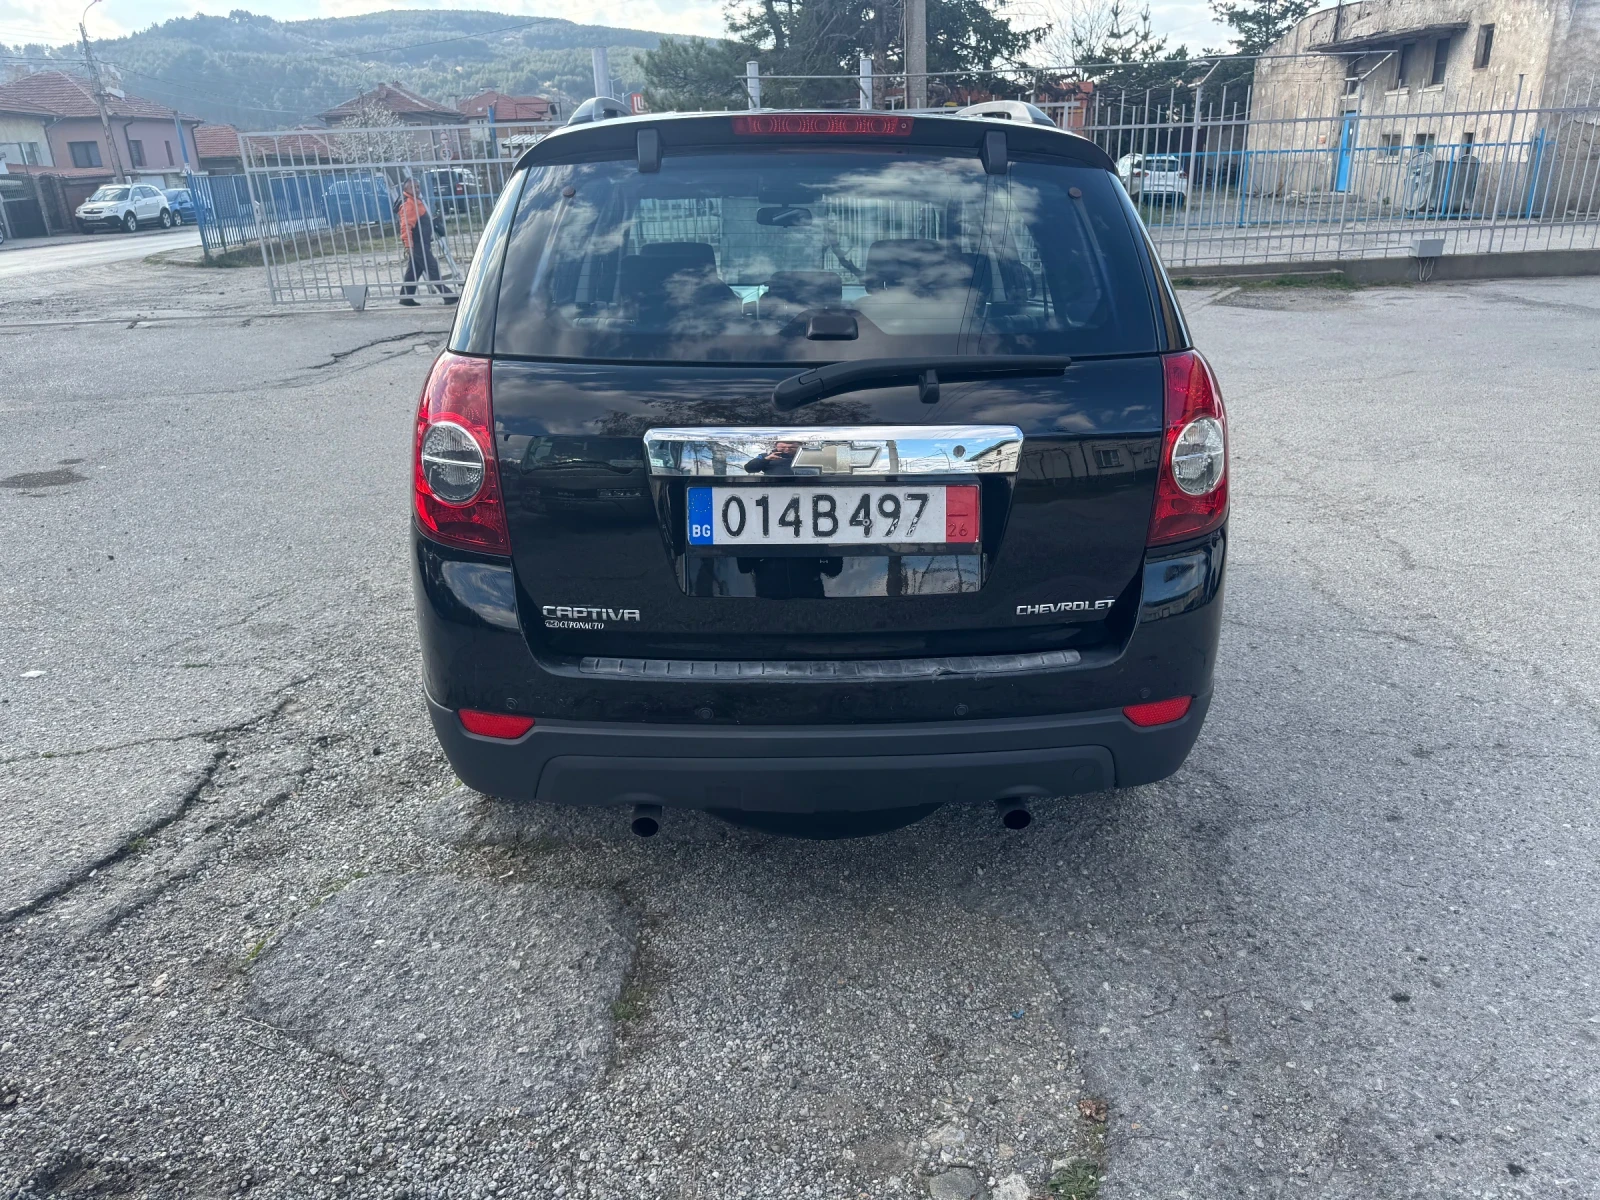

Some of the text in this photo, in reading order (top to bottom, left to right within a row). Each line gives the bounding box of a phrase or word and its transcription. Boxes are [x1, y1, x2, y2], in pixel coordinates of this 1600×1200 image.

[721, 493, 930, 538] 014B497
[692, 524, 711, 537] BG
[947, 523, 968, 537] 26
[542, 606, 640, 621] CAPTIVA
[1016, 600, 1115, 615] CHEVROLET
